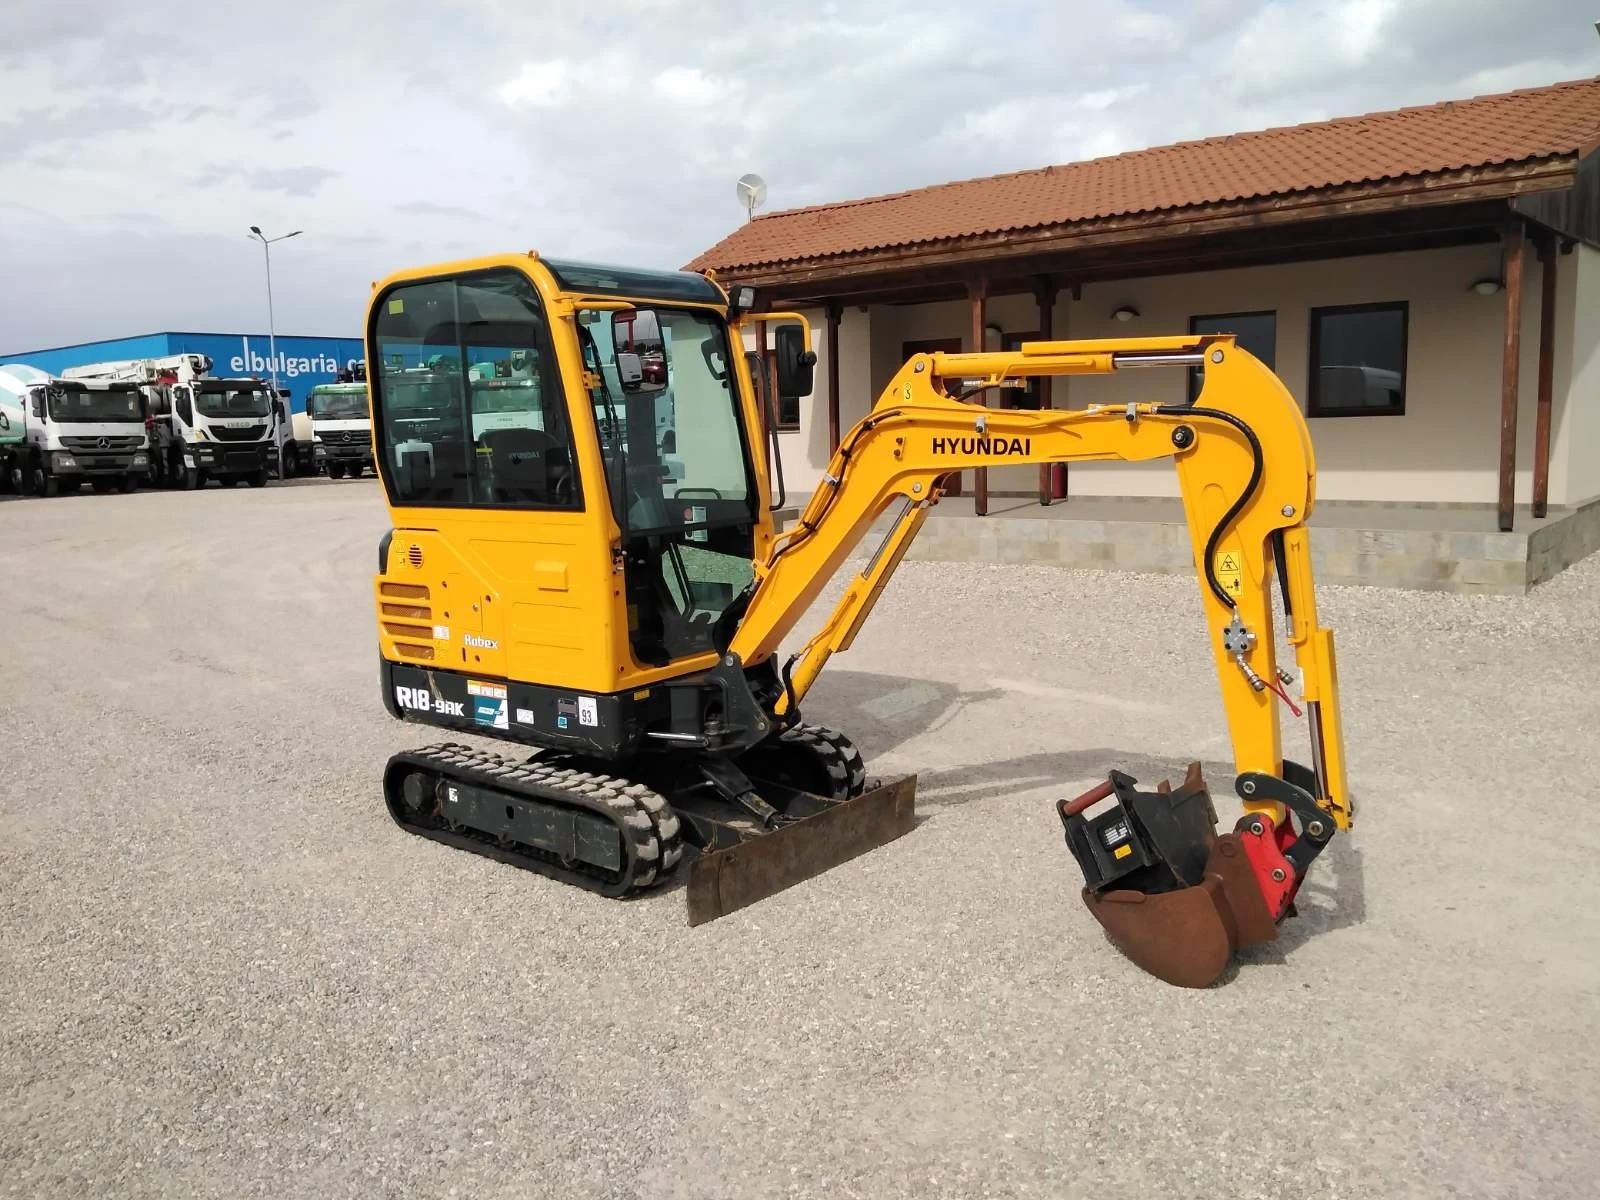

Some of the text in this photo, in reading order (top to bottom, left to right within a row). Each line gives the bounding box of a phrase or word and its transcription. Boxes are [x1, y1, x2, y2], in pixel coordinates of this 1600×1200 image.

[932, 437, 1031, 456] HYUNDAI
[464, 633, 498, 649] Robex
[581, 709, 592, 723] 93
